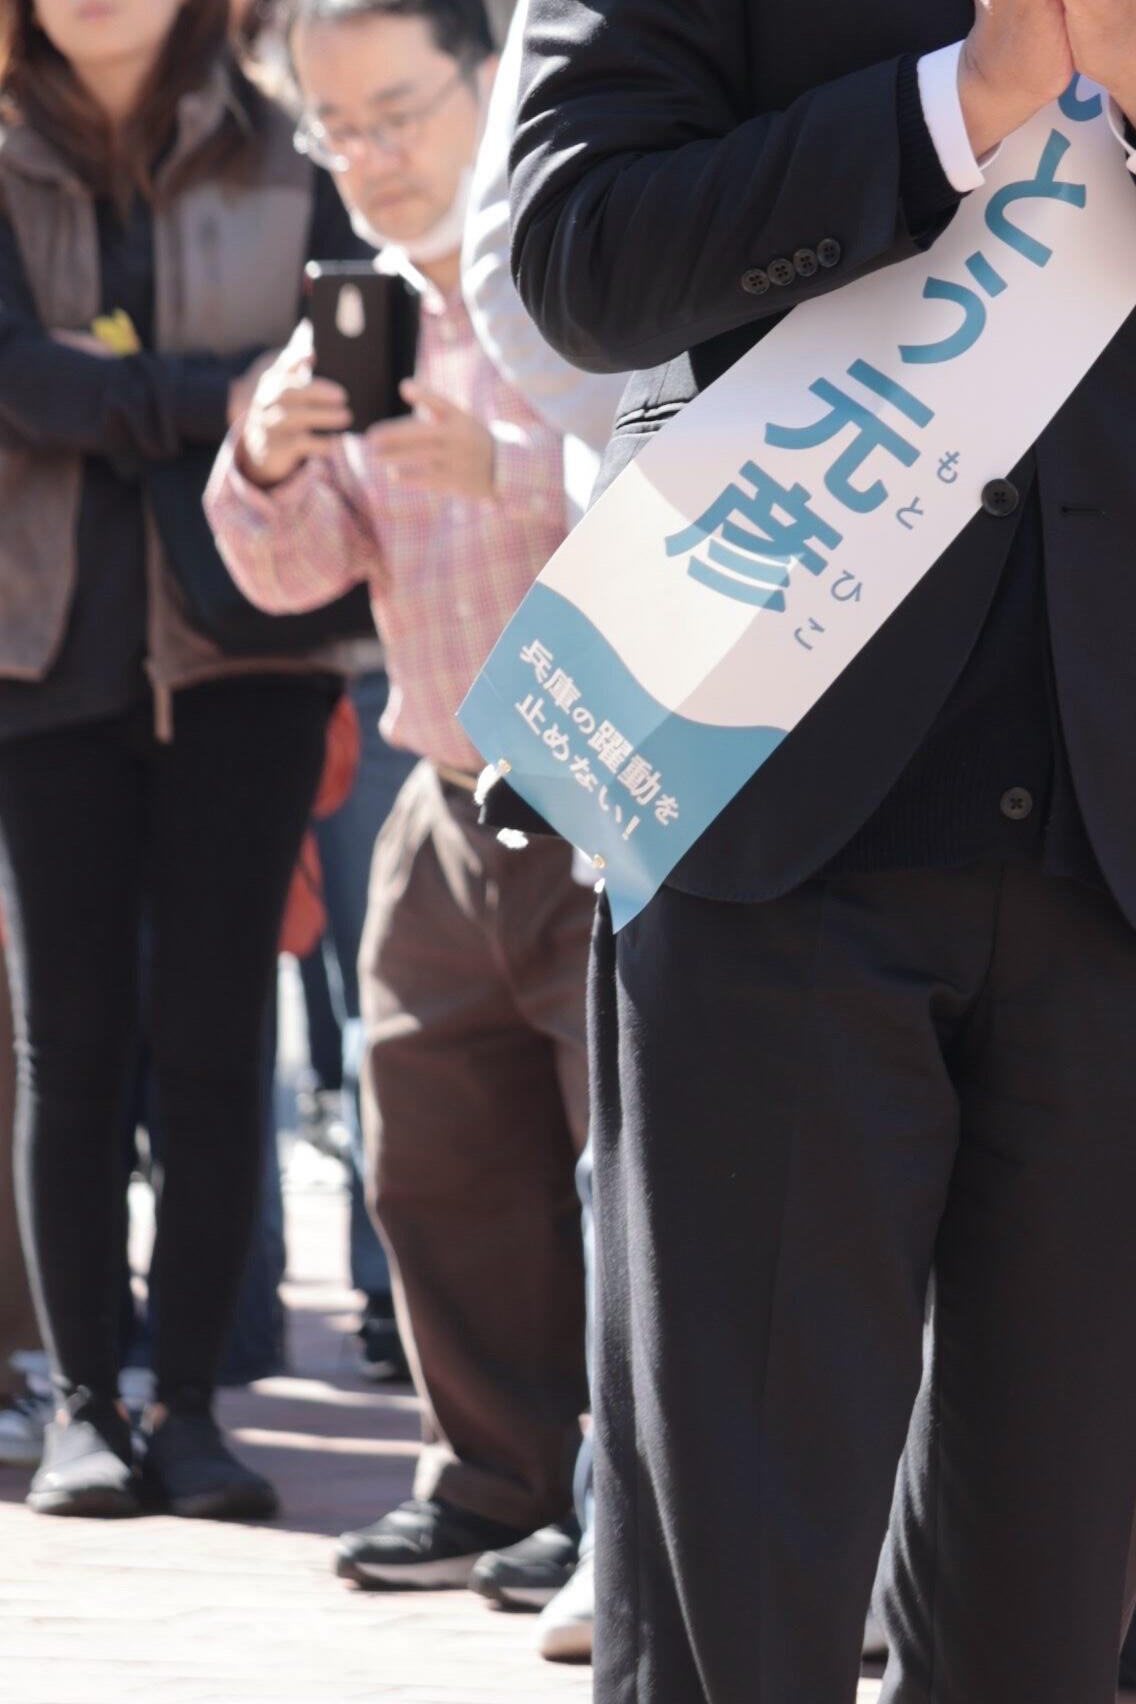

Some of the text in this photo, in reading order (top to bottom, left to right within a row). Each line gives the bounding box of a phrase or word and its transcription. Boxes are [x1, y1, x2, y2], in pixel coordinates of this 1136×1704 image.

[793, 449, 959, 650] もとひこ
[515, 694, 640, 840] 止めない!
[520, 639, 678, 825] 兵庫の躍動を
